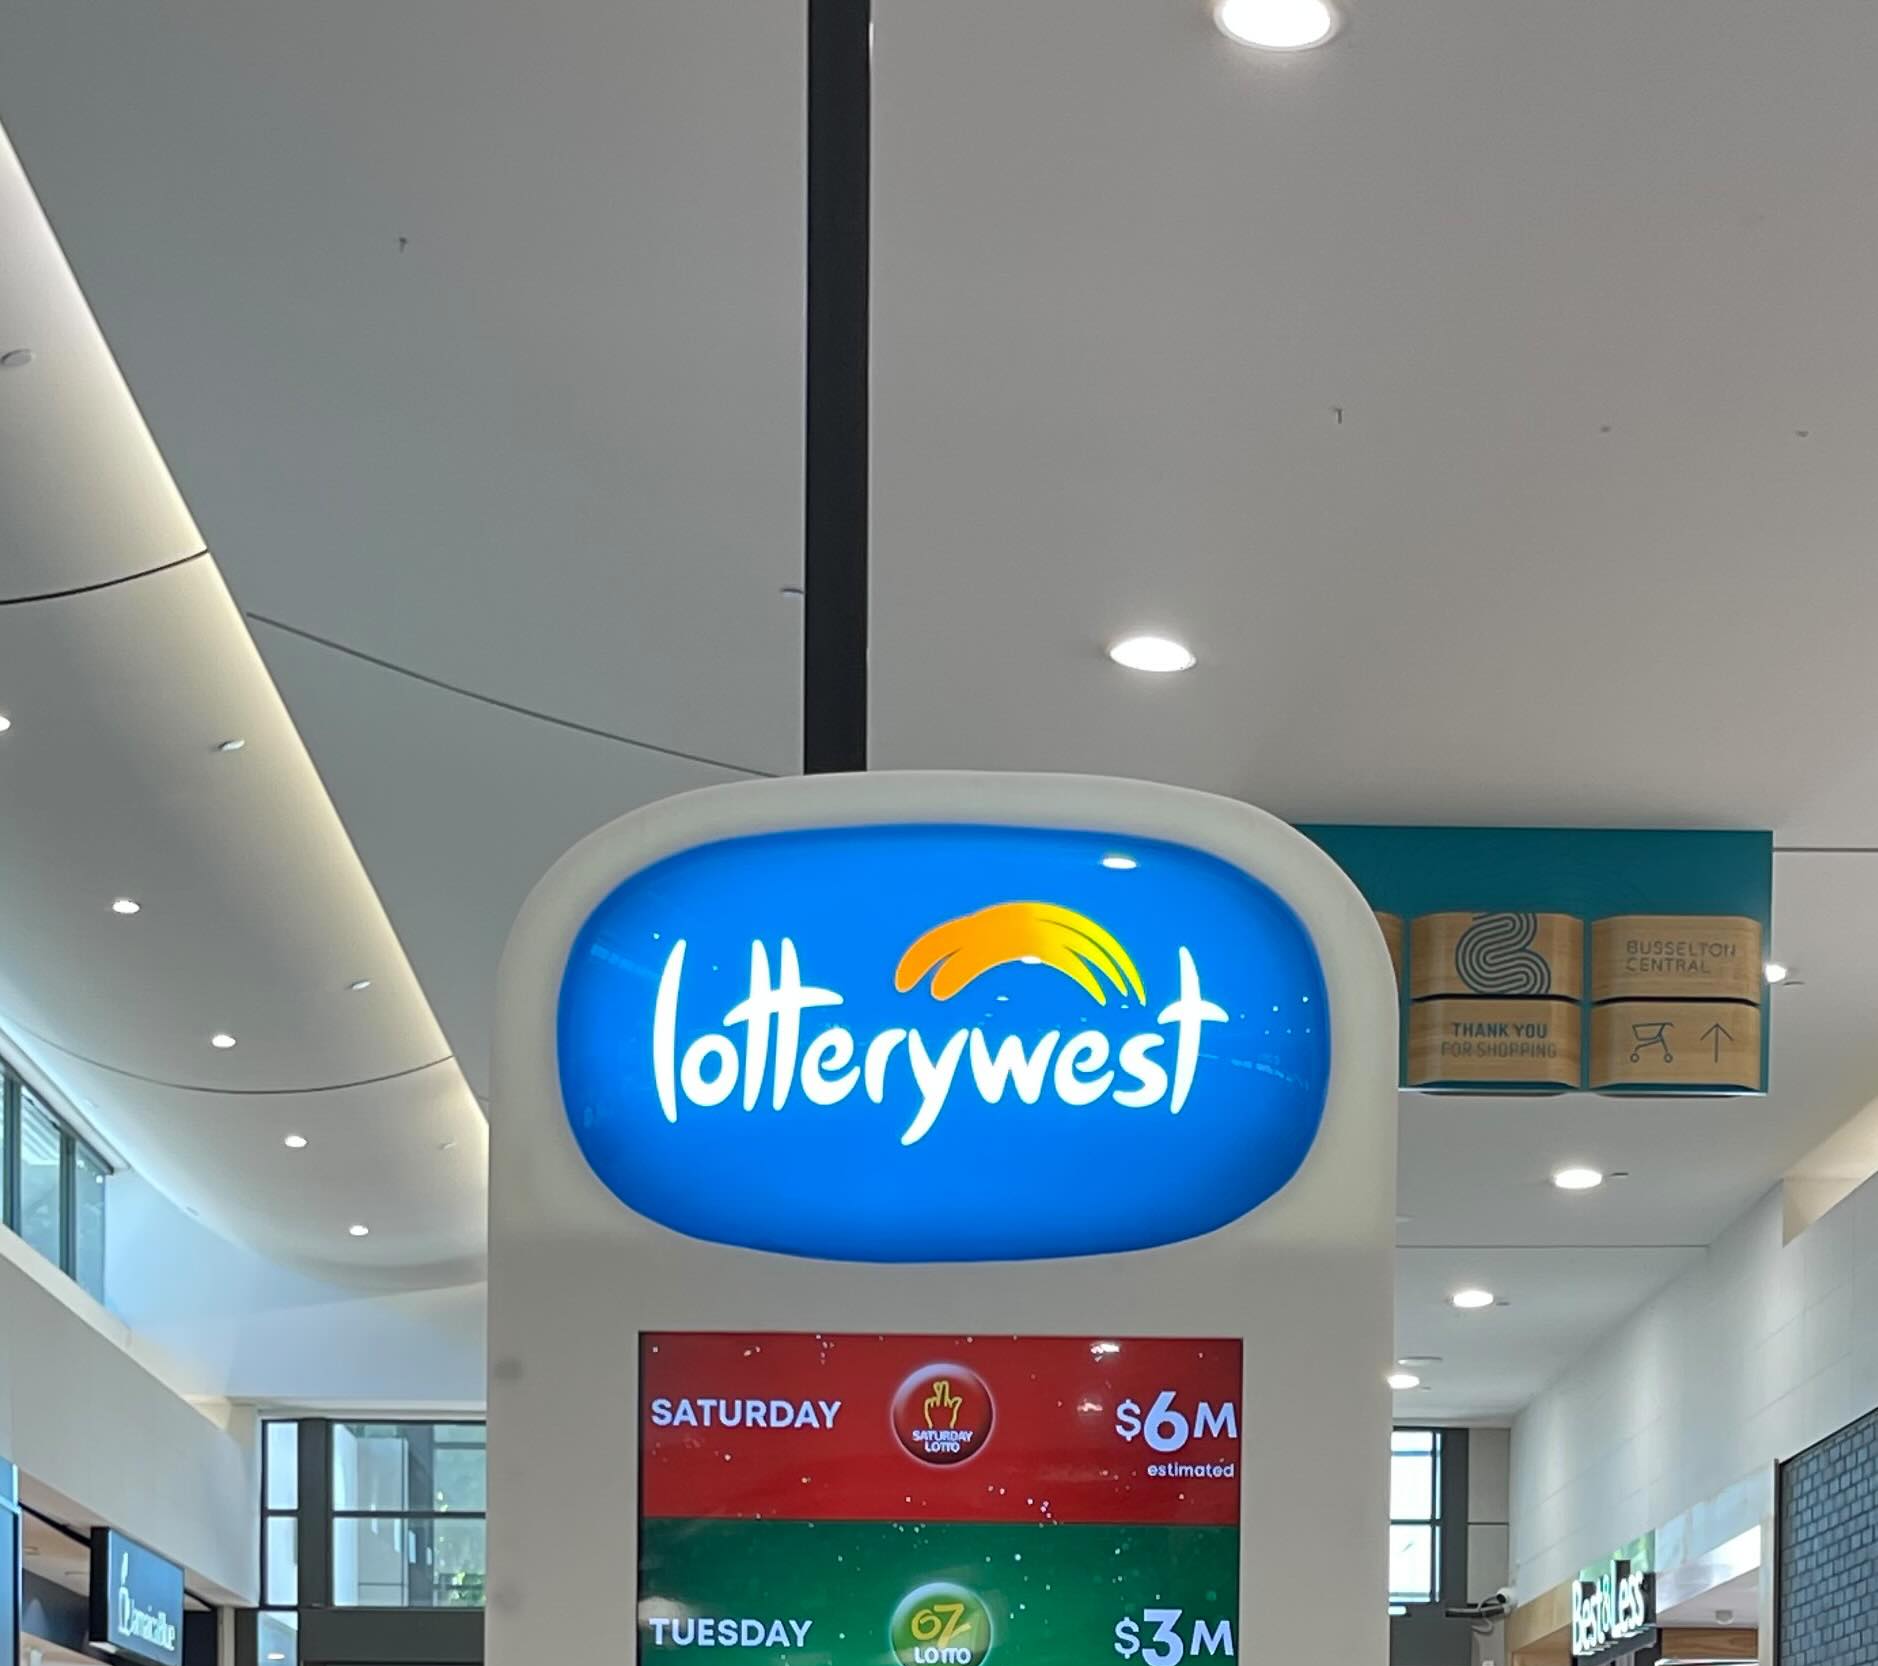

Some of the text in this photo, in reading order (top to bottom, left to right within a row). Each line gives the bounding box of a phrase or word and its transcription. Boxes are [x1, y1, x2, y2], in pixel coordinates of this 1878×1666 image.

[1626, 940, 1737, 958] BUSSELTON
[1625, 957, 1711, 974] CENTRAL
[1452, 1022, 1548, 1039] THANK YOU
[653, 937, 1229, 1145] lotterywest
[1441, 1042, 1557, 1059] FOR SHOPPING
[651, 1398, 842, 1429] SATURDAY
[912, 1430, 973, 1442] SATURDAY
[925, 1441, 961, 1453] LOTTO
[1147, 1462, 1235, 1478] estimated
[648, 1617, 813, 1648] TUESDAY
[914, 1646, 972, 1665] LOTTO
